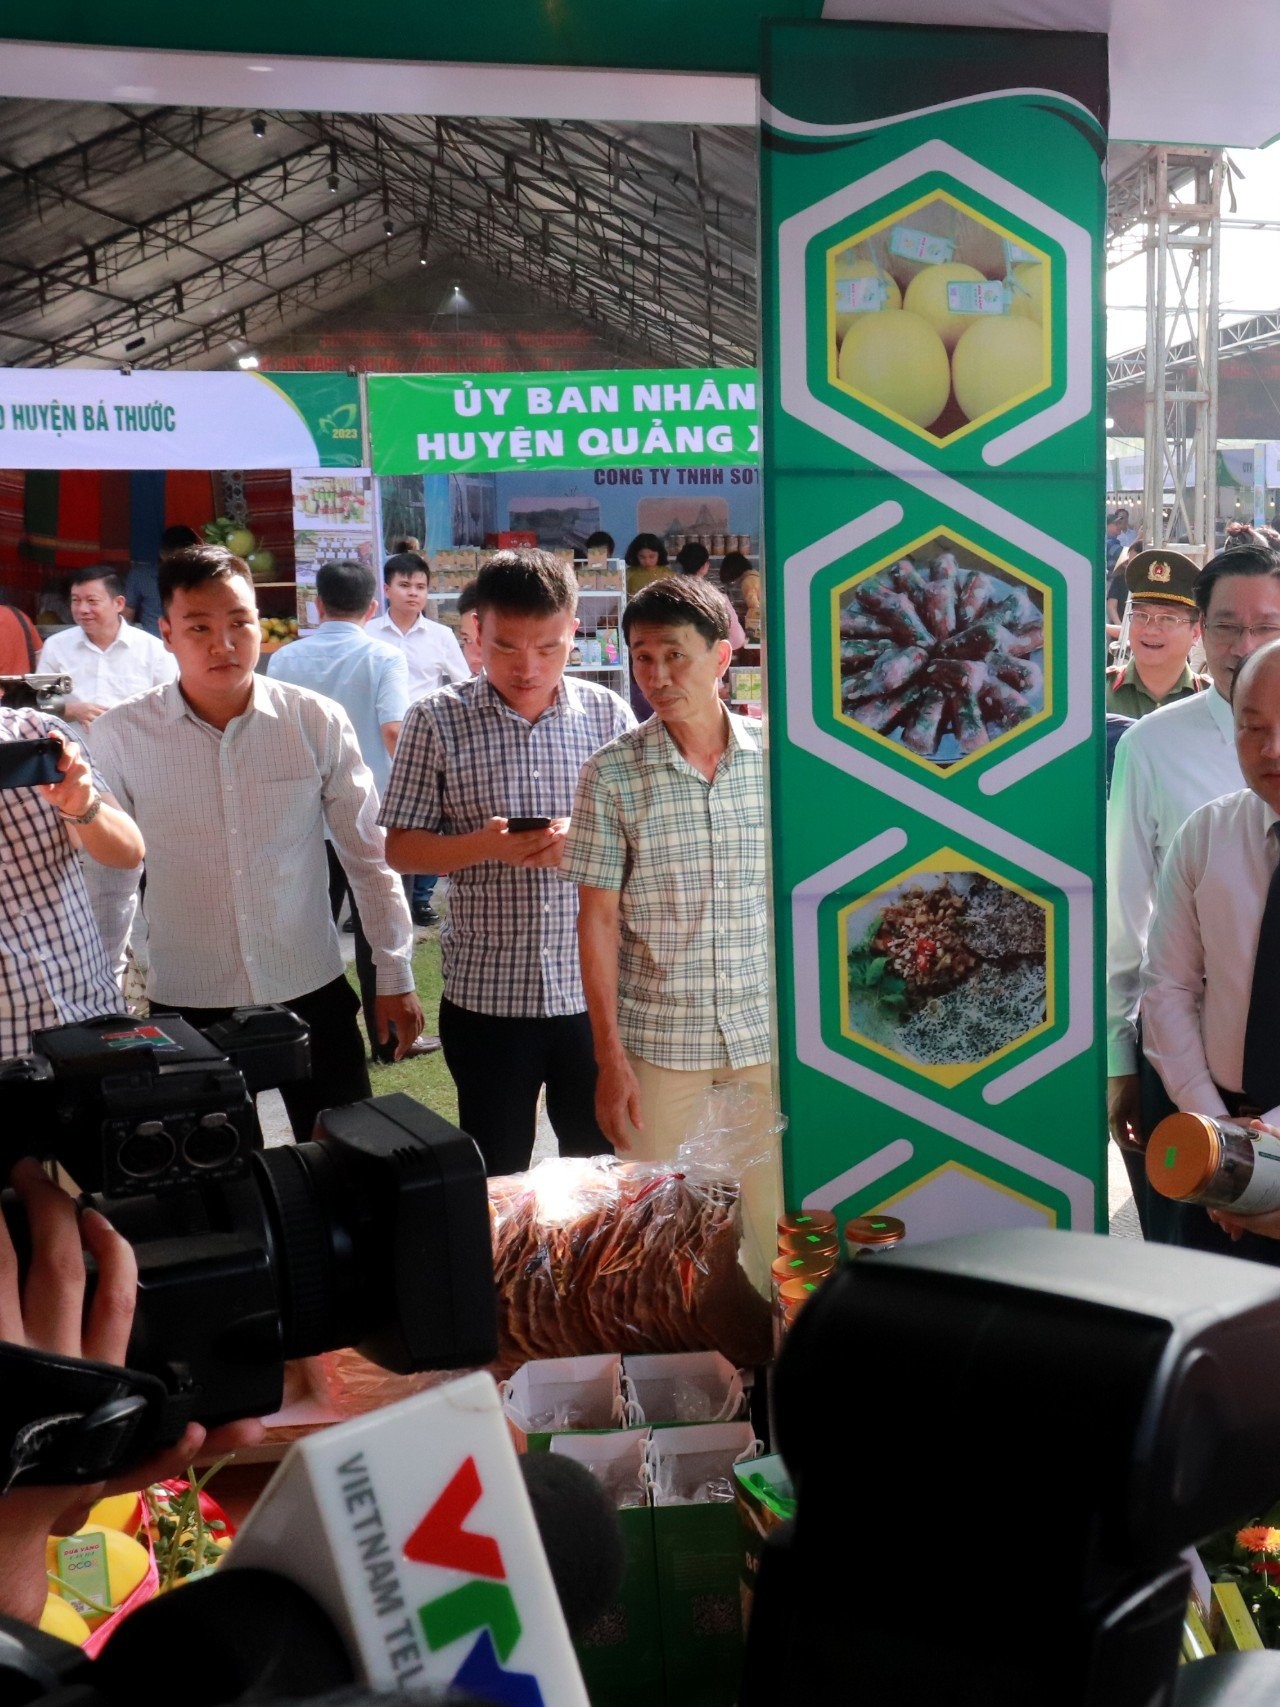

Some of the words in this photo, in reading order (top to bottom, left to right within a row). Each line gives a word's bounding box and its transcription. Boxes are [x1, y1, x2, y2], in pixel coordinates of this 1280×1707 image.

[453, 380, 512, 417] ỦY
[527, 385, 619, 415] BAN
[633, 379, 756, 412] NHÂN
[12, 400, 75, 437] HUYỆN
[83, 400, 108, 432] BÁ
[114, 400, 176, 432] THƯỚC
[332, 428, 357, 439] 2023
[416, 426, 564, 463] HUYỆN
[577, 418, 733, 456] QUẢNG
[650, 468, 671, 485] TY
[676, 468, 724, 485] TNHH
[336, 1451, 406, 1618] VIETNAM
[384, 1617, 428, 1692] TEL
